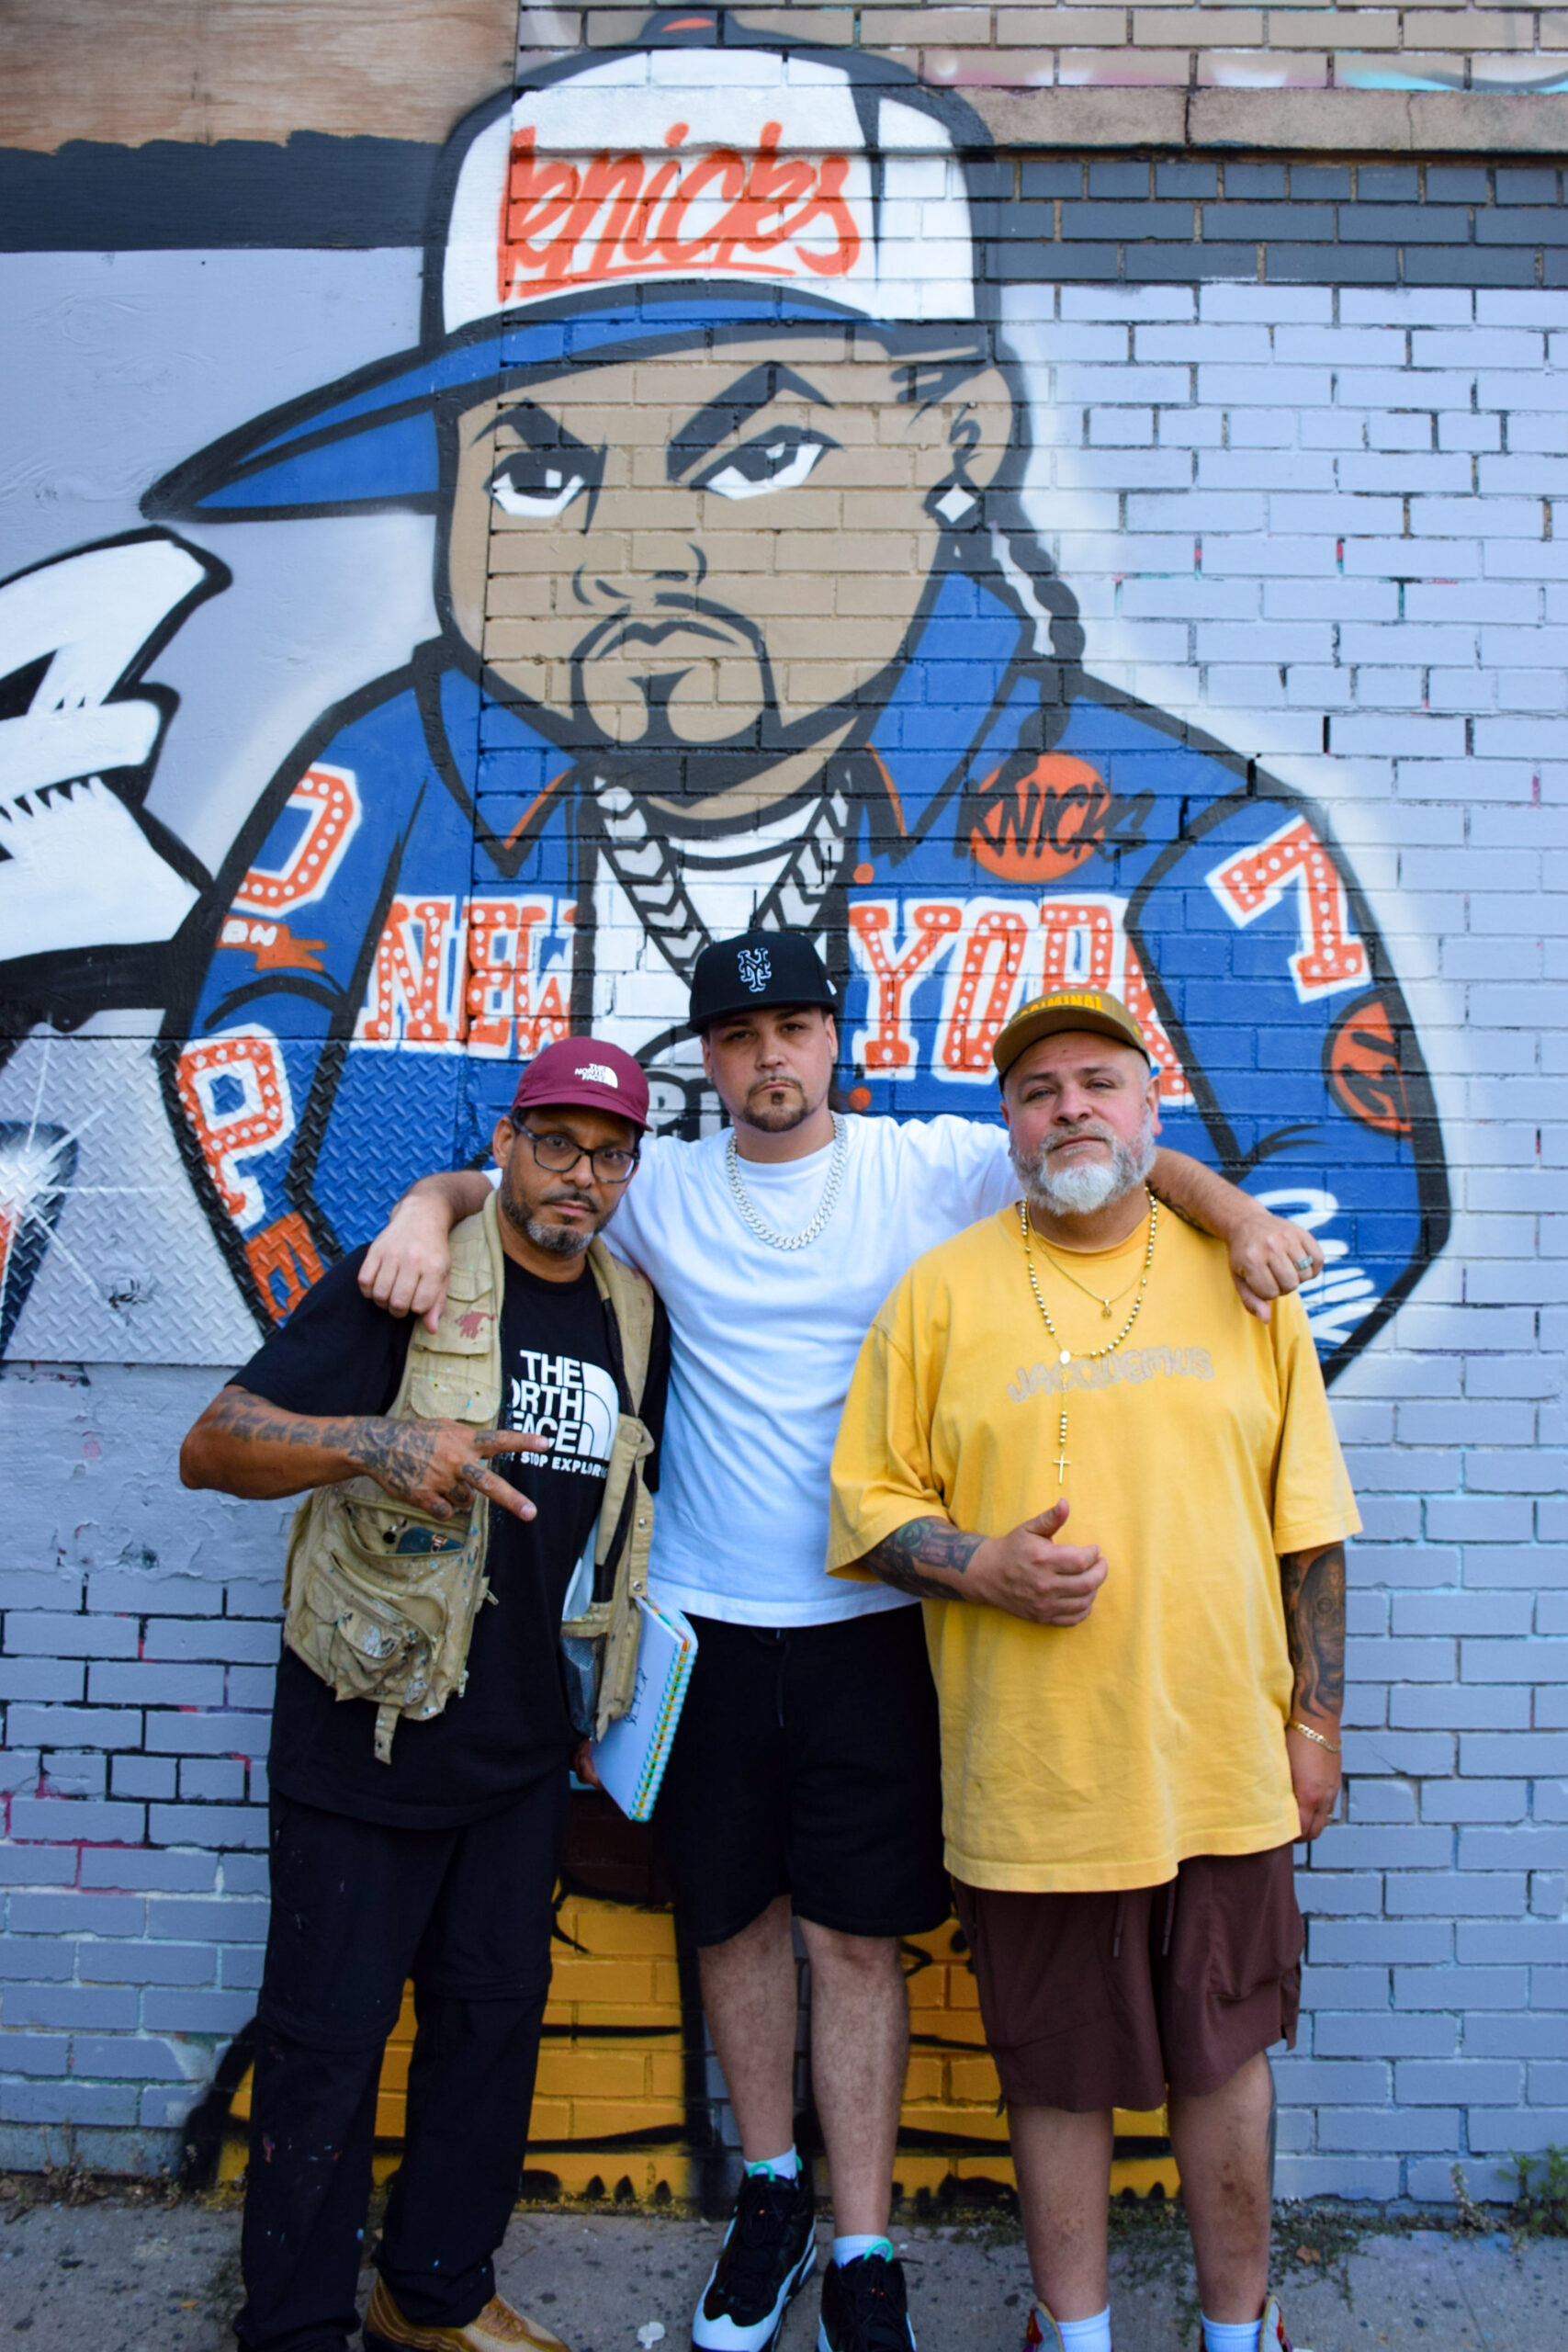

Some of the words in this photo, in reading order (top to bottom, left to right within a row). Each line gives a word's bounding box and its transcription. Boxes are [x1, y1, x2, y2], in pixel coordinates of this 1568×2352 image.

[347, 894, 577, 1060] NEW
[847, 893, 1196, 1104] YORK
[1021, 995, 1103, 1016] MINAL
[520, 1350, 583, 1388] THE
[1006, 1345, 1215, 1404] JACQUEMUS
[512, 1378, 582, 1421] RTH
[520, 1452, 548, 1467] STOP
[551, 1456, 608, 1478] EXPLOR
